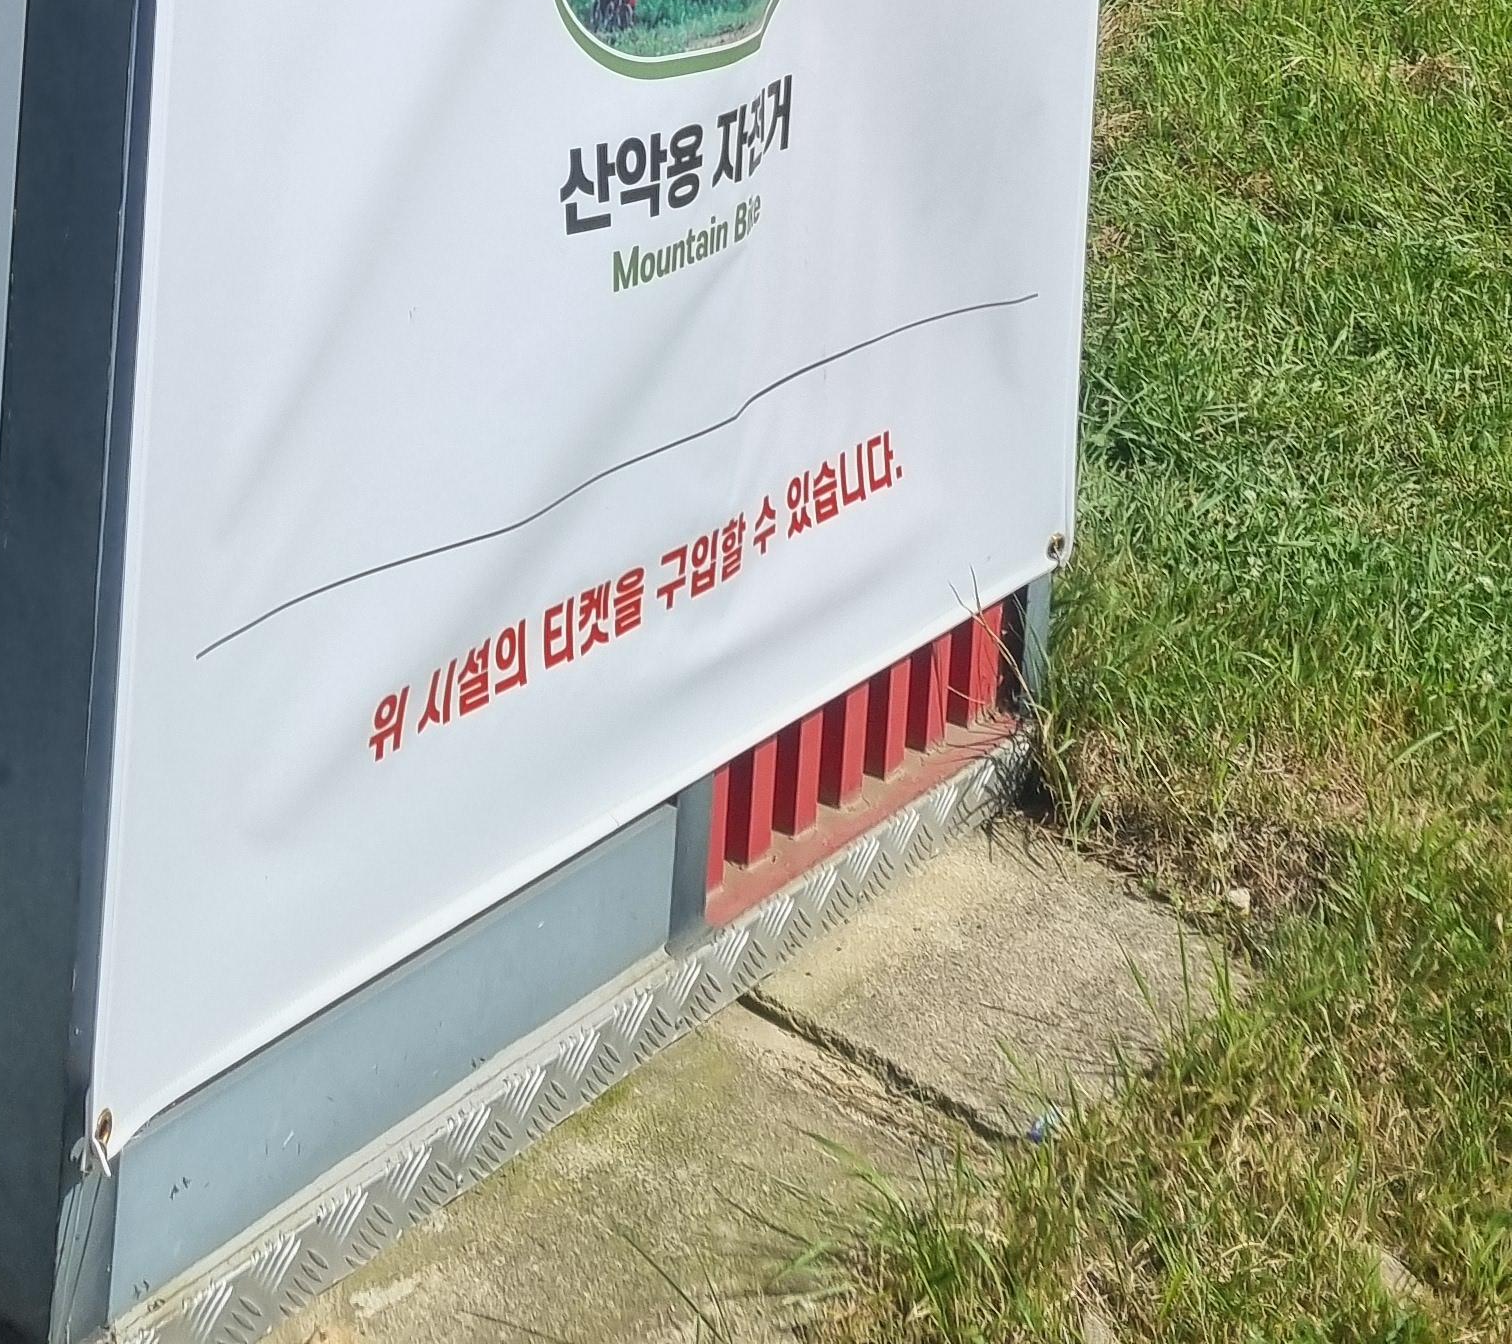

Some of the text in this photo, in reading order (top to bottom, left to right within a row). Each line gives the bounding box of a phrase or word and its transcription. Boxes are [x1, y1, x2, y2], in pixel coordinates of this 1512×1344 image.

[559, 74, 793, 235] 산악용 자전거
[613, 215, 729, 292] Mountain
[367, 430, 904, 763] 위 시설의 티켓을 구입할 수 있습니다.
